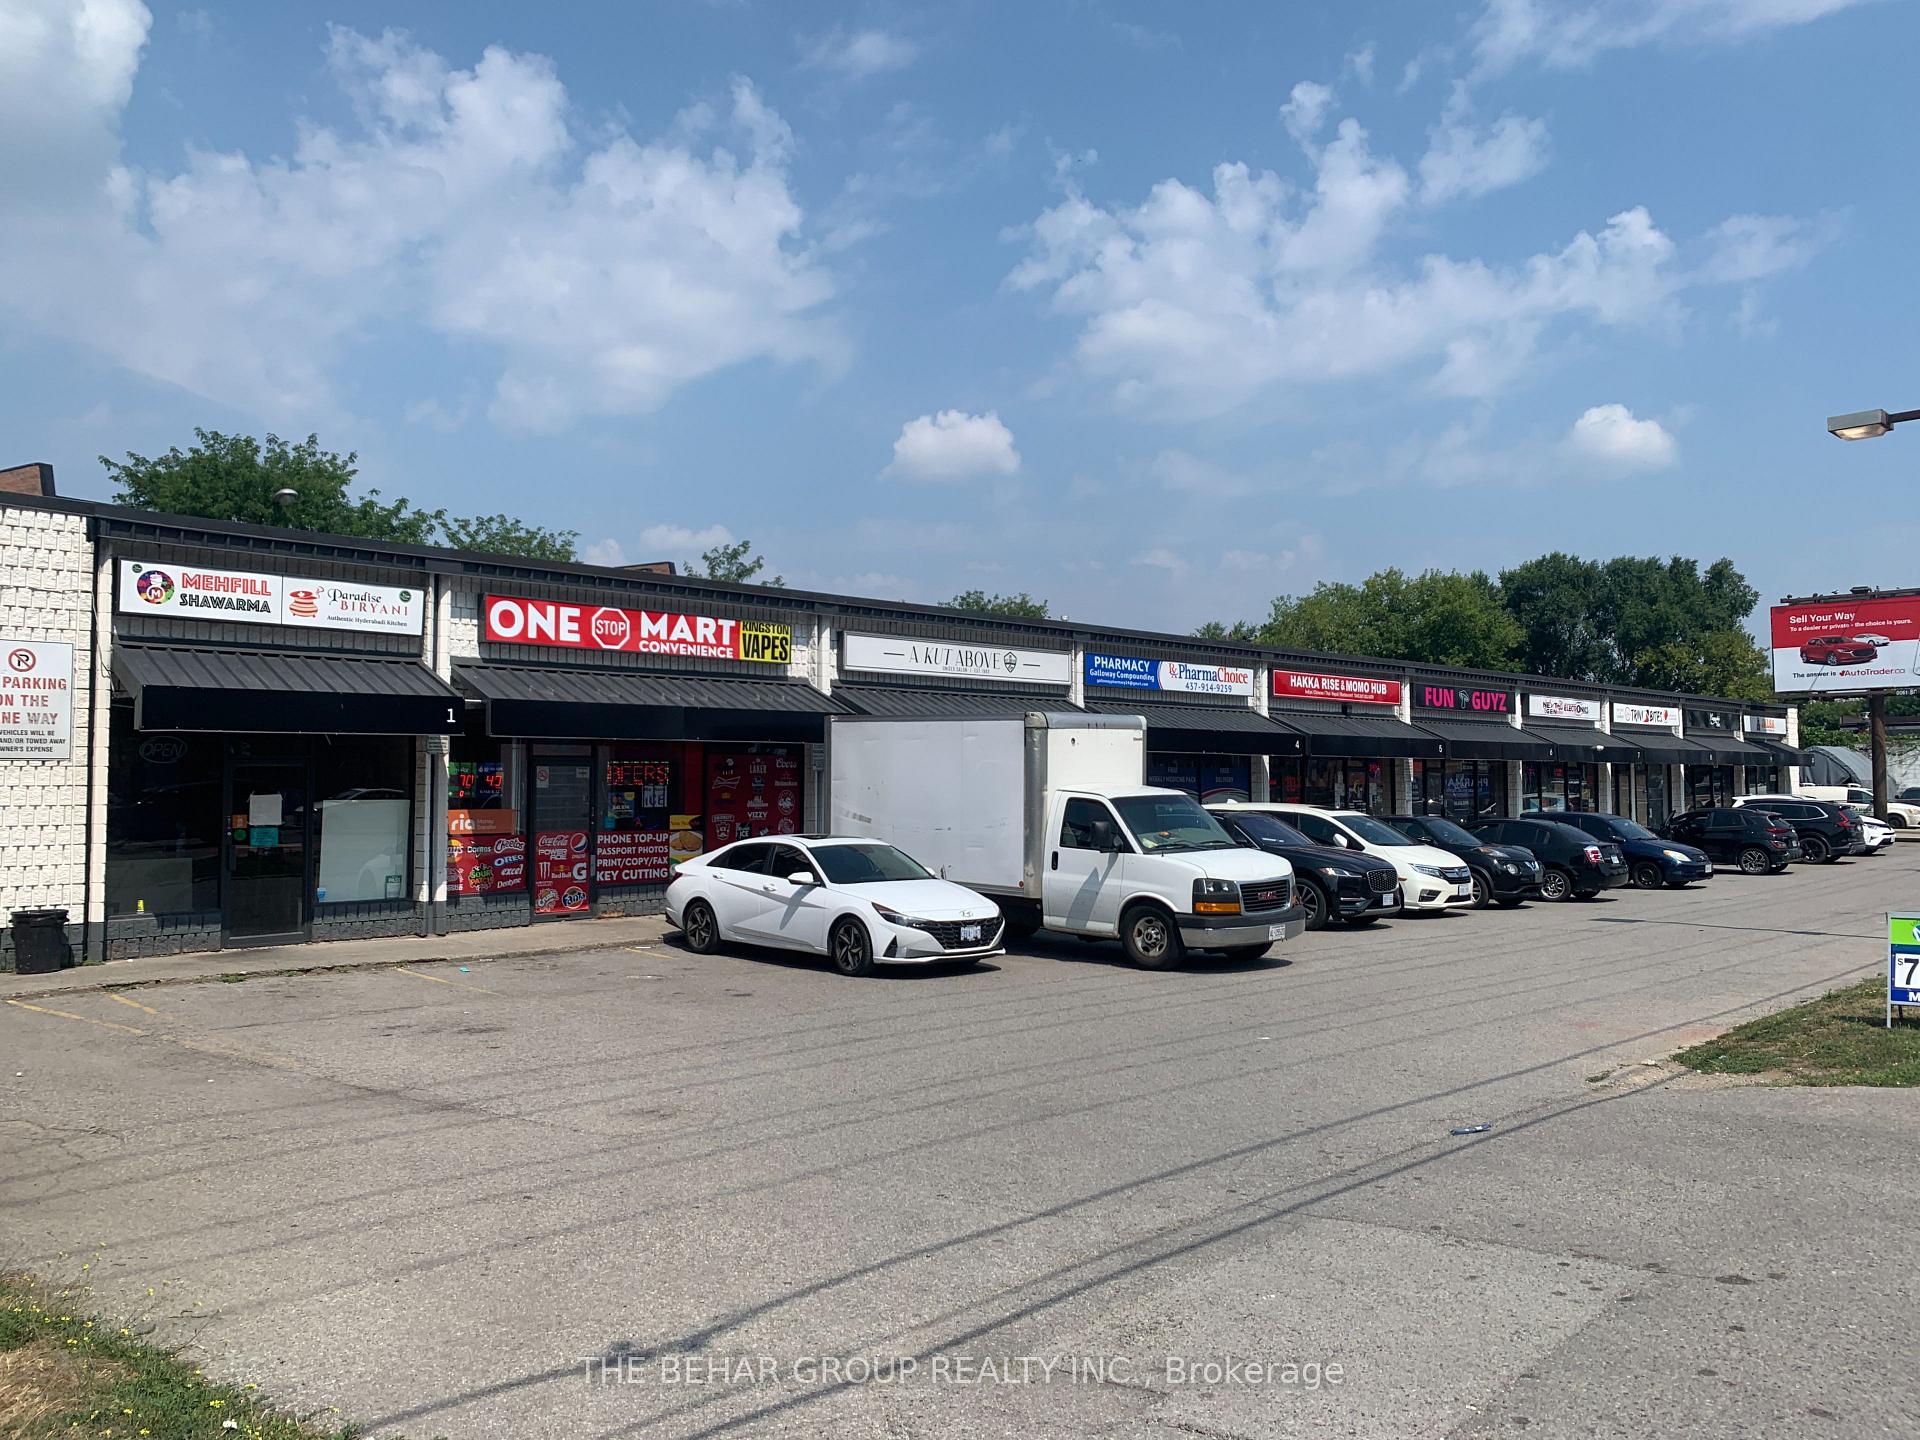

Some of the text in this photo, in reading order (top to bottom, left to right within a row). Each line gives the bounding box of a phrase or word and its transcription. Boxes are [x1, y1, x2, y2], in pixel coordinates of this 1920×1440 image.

[182, 572, 272, 596] MEHFILL
[180, 594, 270, 613] SHAWARMA
[328, 588, 382, 606] Paradise
[341, 600, 408, 616] BIRYANI
[490, 600, 736, 645] ONE STOP MART
[1790, 612, 1856, 624] Sell Your Way
[1894, 618, 1912, 626] yours.
[742, 621, 789, 635] KINGSTON
[639, 640, 734, 658] CONVENIENCE
[742, 633, 788, 661] VAPES
[909, 646, 1000, 670] A KUT ABOVE
[1094, 656, 1150, 672] PHARMACY
[1090, 668, 1154, 682] Galloway Compounding
[1178, 664, 1248, 684] PharmaChoice
[2, 676, 67, 690] PARKING
[1186, 682, 1232, 692] 437-914-9259
[1290, 675, 1387, 694] HAKKA RISE & MOMO HUB
[20, 694, 48, 707] THE
[1425, 687, 1506, 711] FUN GUYZ
[0, 712, 58, 724] NE WAY
[446, 708, 456, 722] 1
[1294, 740, 1300, 750] 4
[1438, 744, 1443, 752] 5
[452, 814, 475, 830] ria
[597, 833, 669, 844] PHONE TOP-UP
[538, 848, 568, 856] POWER
[596, 845, 669, 856] PASSPORT PHOTOS
[494, 855, 524, 866] OREO
[596, 856, 668, 868] PRINT/COPY/FAX
[501, 864, 524, 876] excel
[572, 862, 587, 880] G
[596, 868, 669, 882] KEY CUTTING
[562, 890, 586, 906] Fanta
